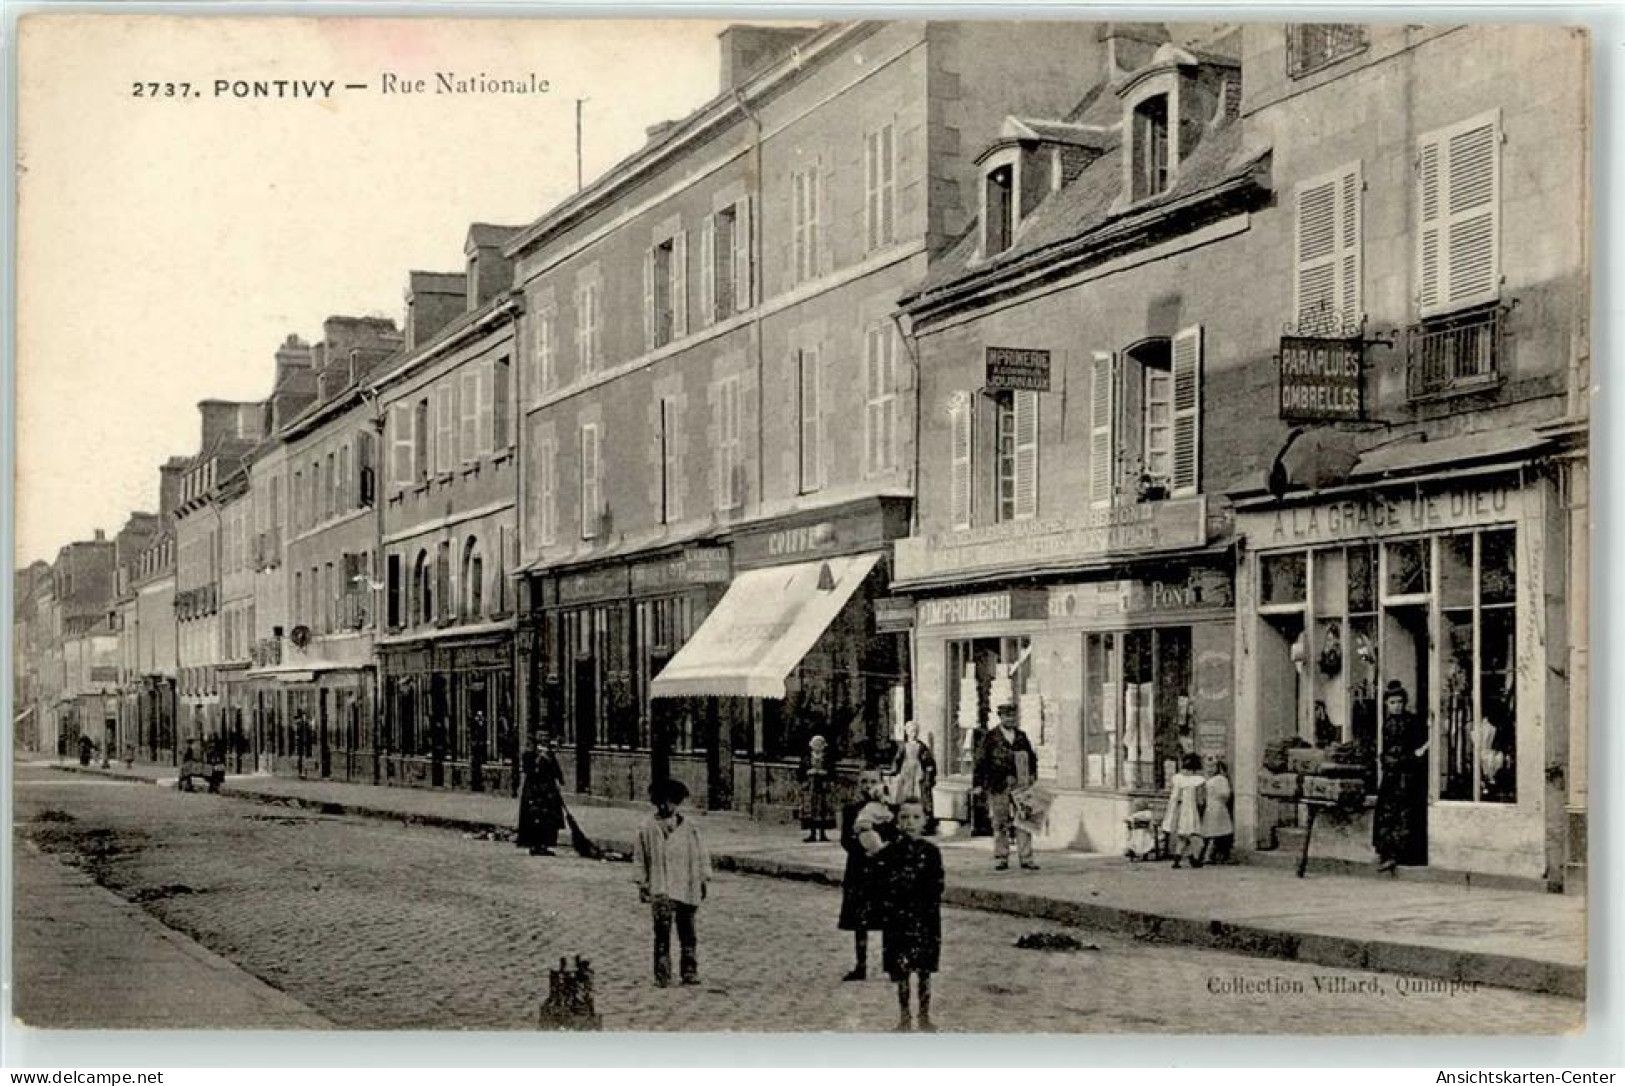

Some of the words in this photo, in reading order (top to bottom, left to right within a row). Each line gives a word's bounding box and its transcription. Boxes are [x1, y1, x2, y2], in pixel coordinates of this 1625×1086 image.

[1282, 347, 1359, 377] PARAPLUIES
[1282, 385, 1359, 411] OMBRELLES
[1292, 508, 1319, 536] LA
[1327, 500, 1400, 533] GRACE
[1410, 501, 1441, 527] DE
[1450, 487, 1506, 519] DIEU
